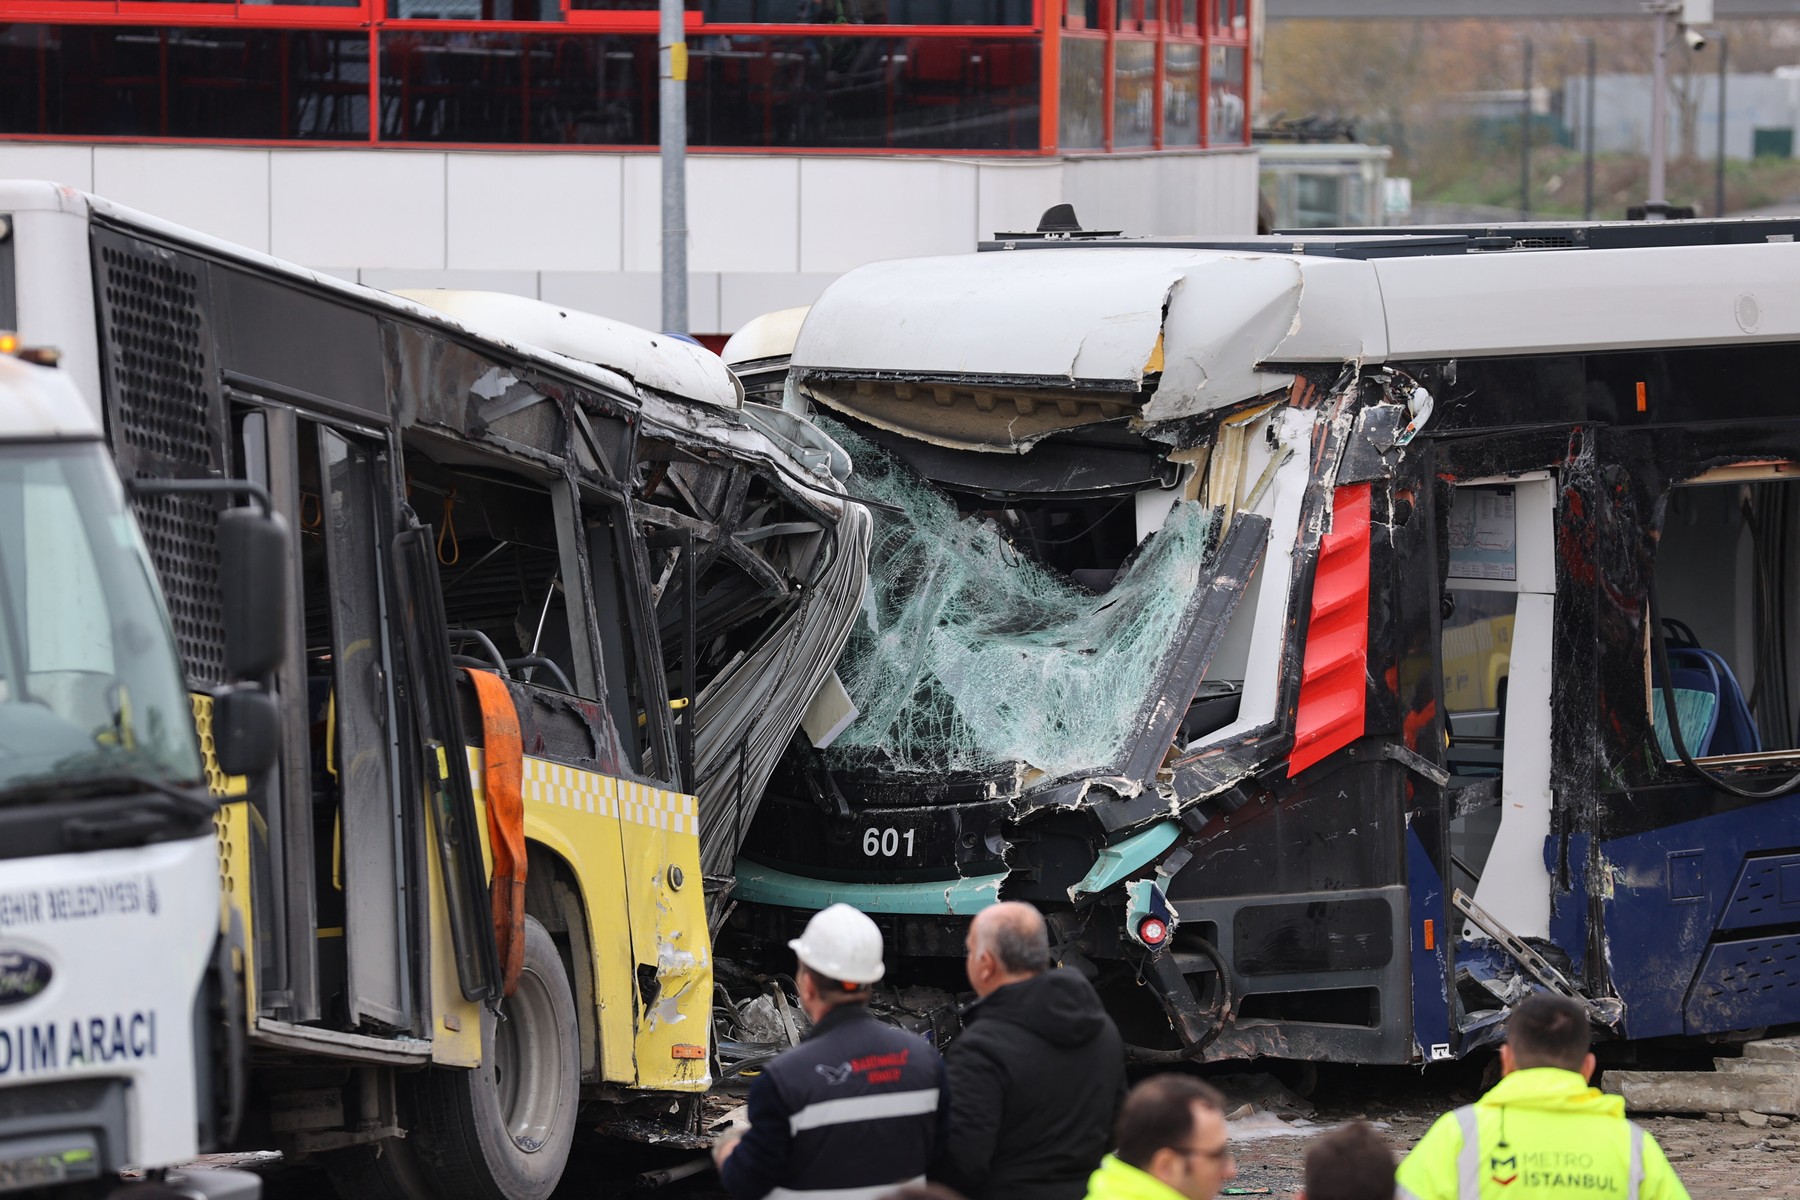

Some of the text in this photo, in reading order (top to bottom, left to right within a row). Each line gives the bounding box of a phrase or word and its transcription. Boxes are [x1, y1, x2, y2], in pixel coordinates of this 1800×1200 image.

[862, 827, 915, 857] 601
[67, 1010, 156, 1065] ARACI
[1522, 1151, 1594, 1170] METRO
